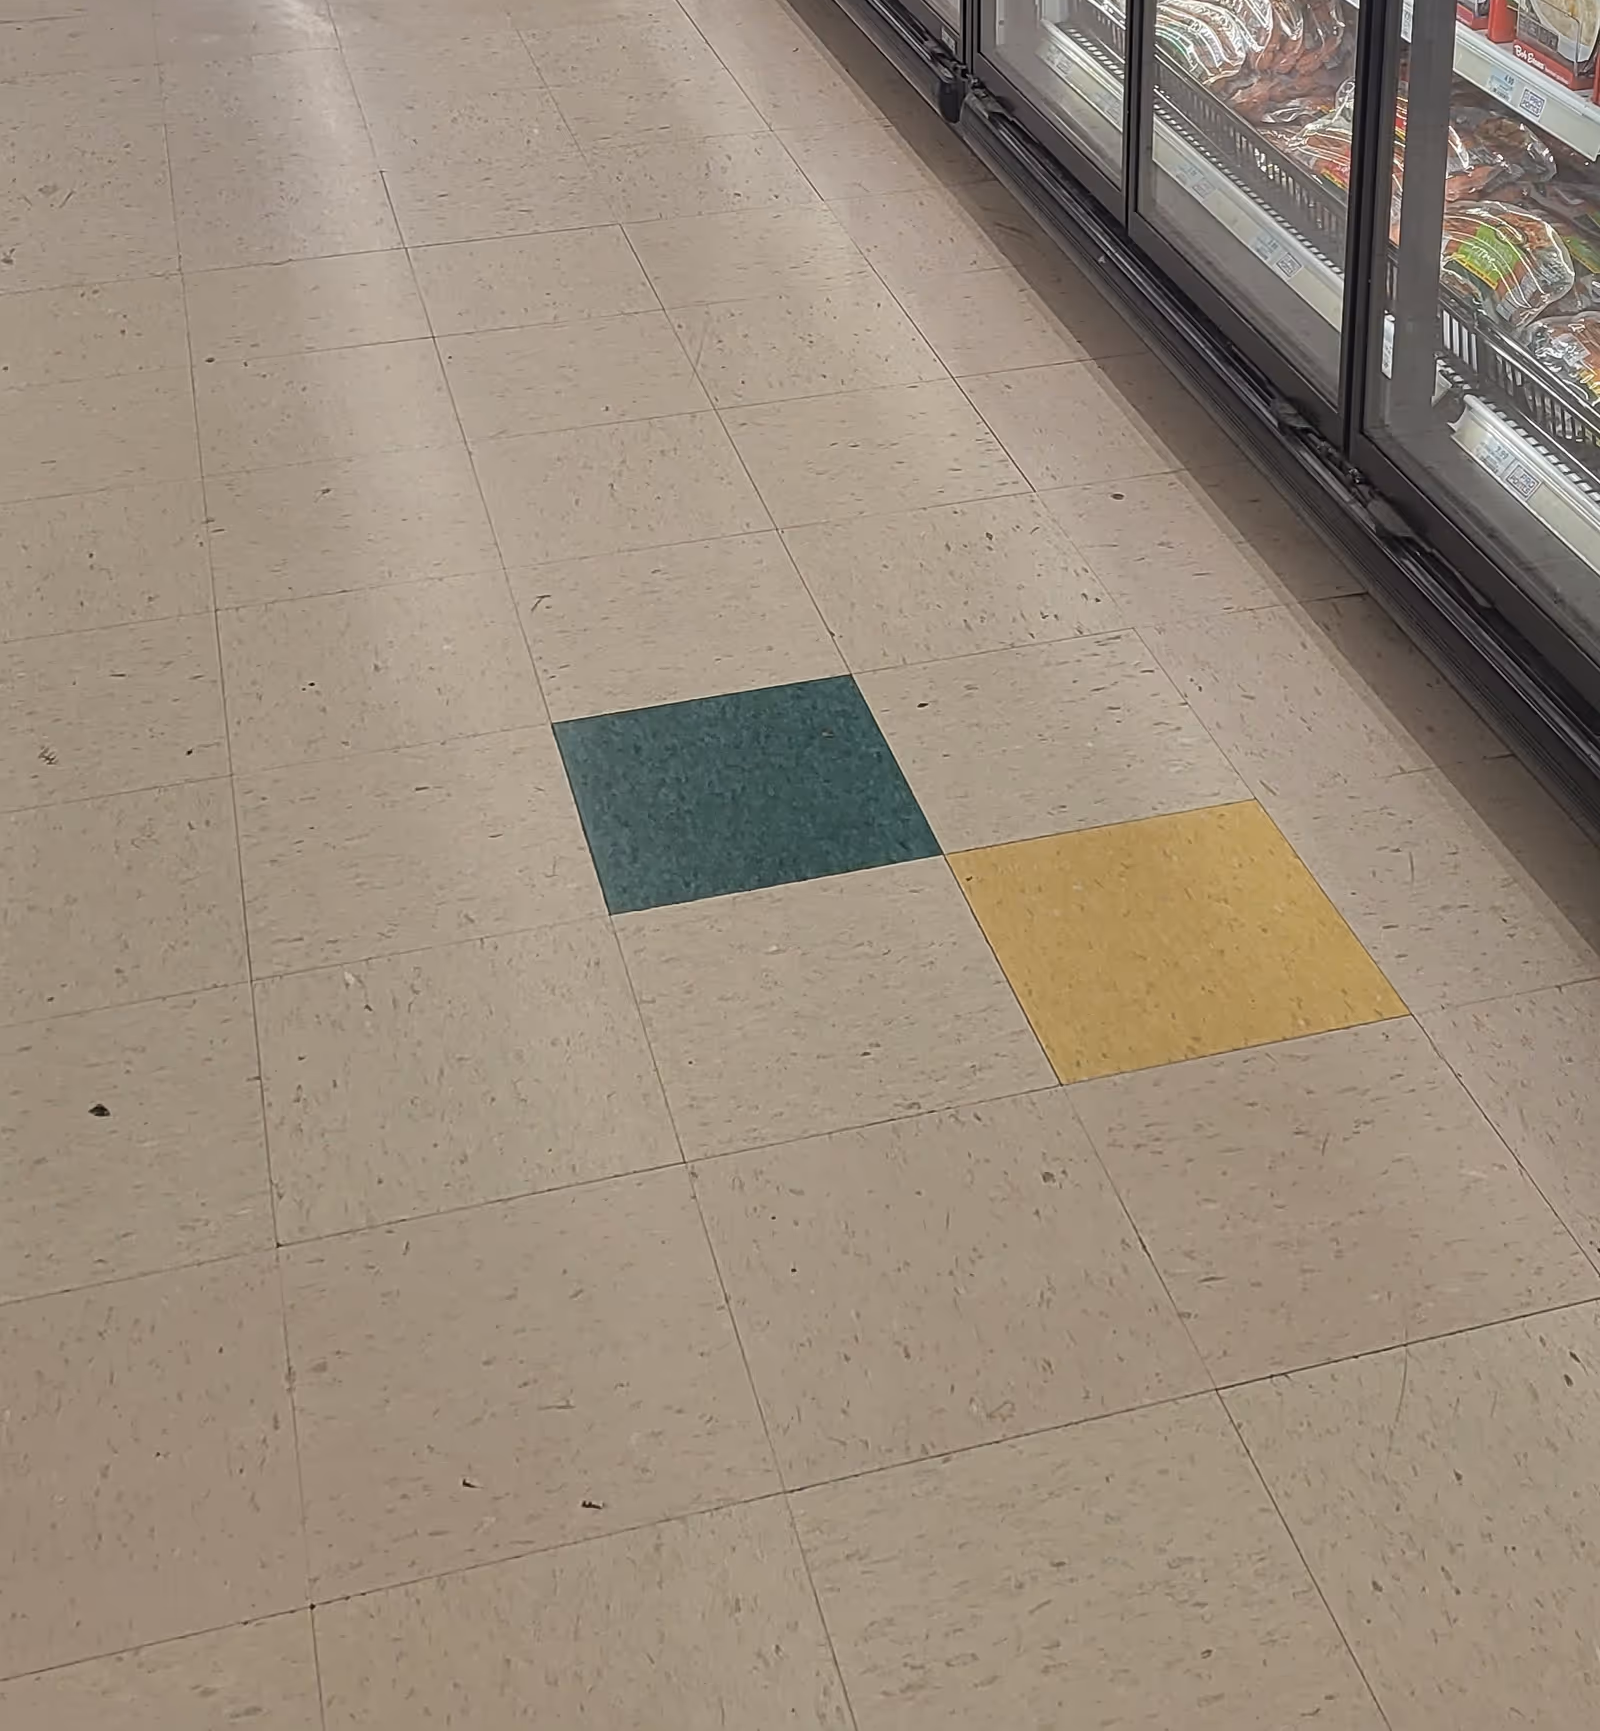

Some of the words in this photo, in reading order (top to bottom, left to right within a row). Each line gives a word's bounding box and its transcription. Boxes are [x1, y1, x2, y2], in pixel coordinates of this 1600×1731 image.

[1514, 44, 1528, 60] Bob
[1527, 50, 1545, 70] Evans
[1519, 474, 1536, 488] PRO
